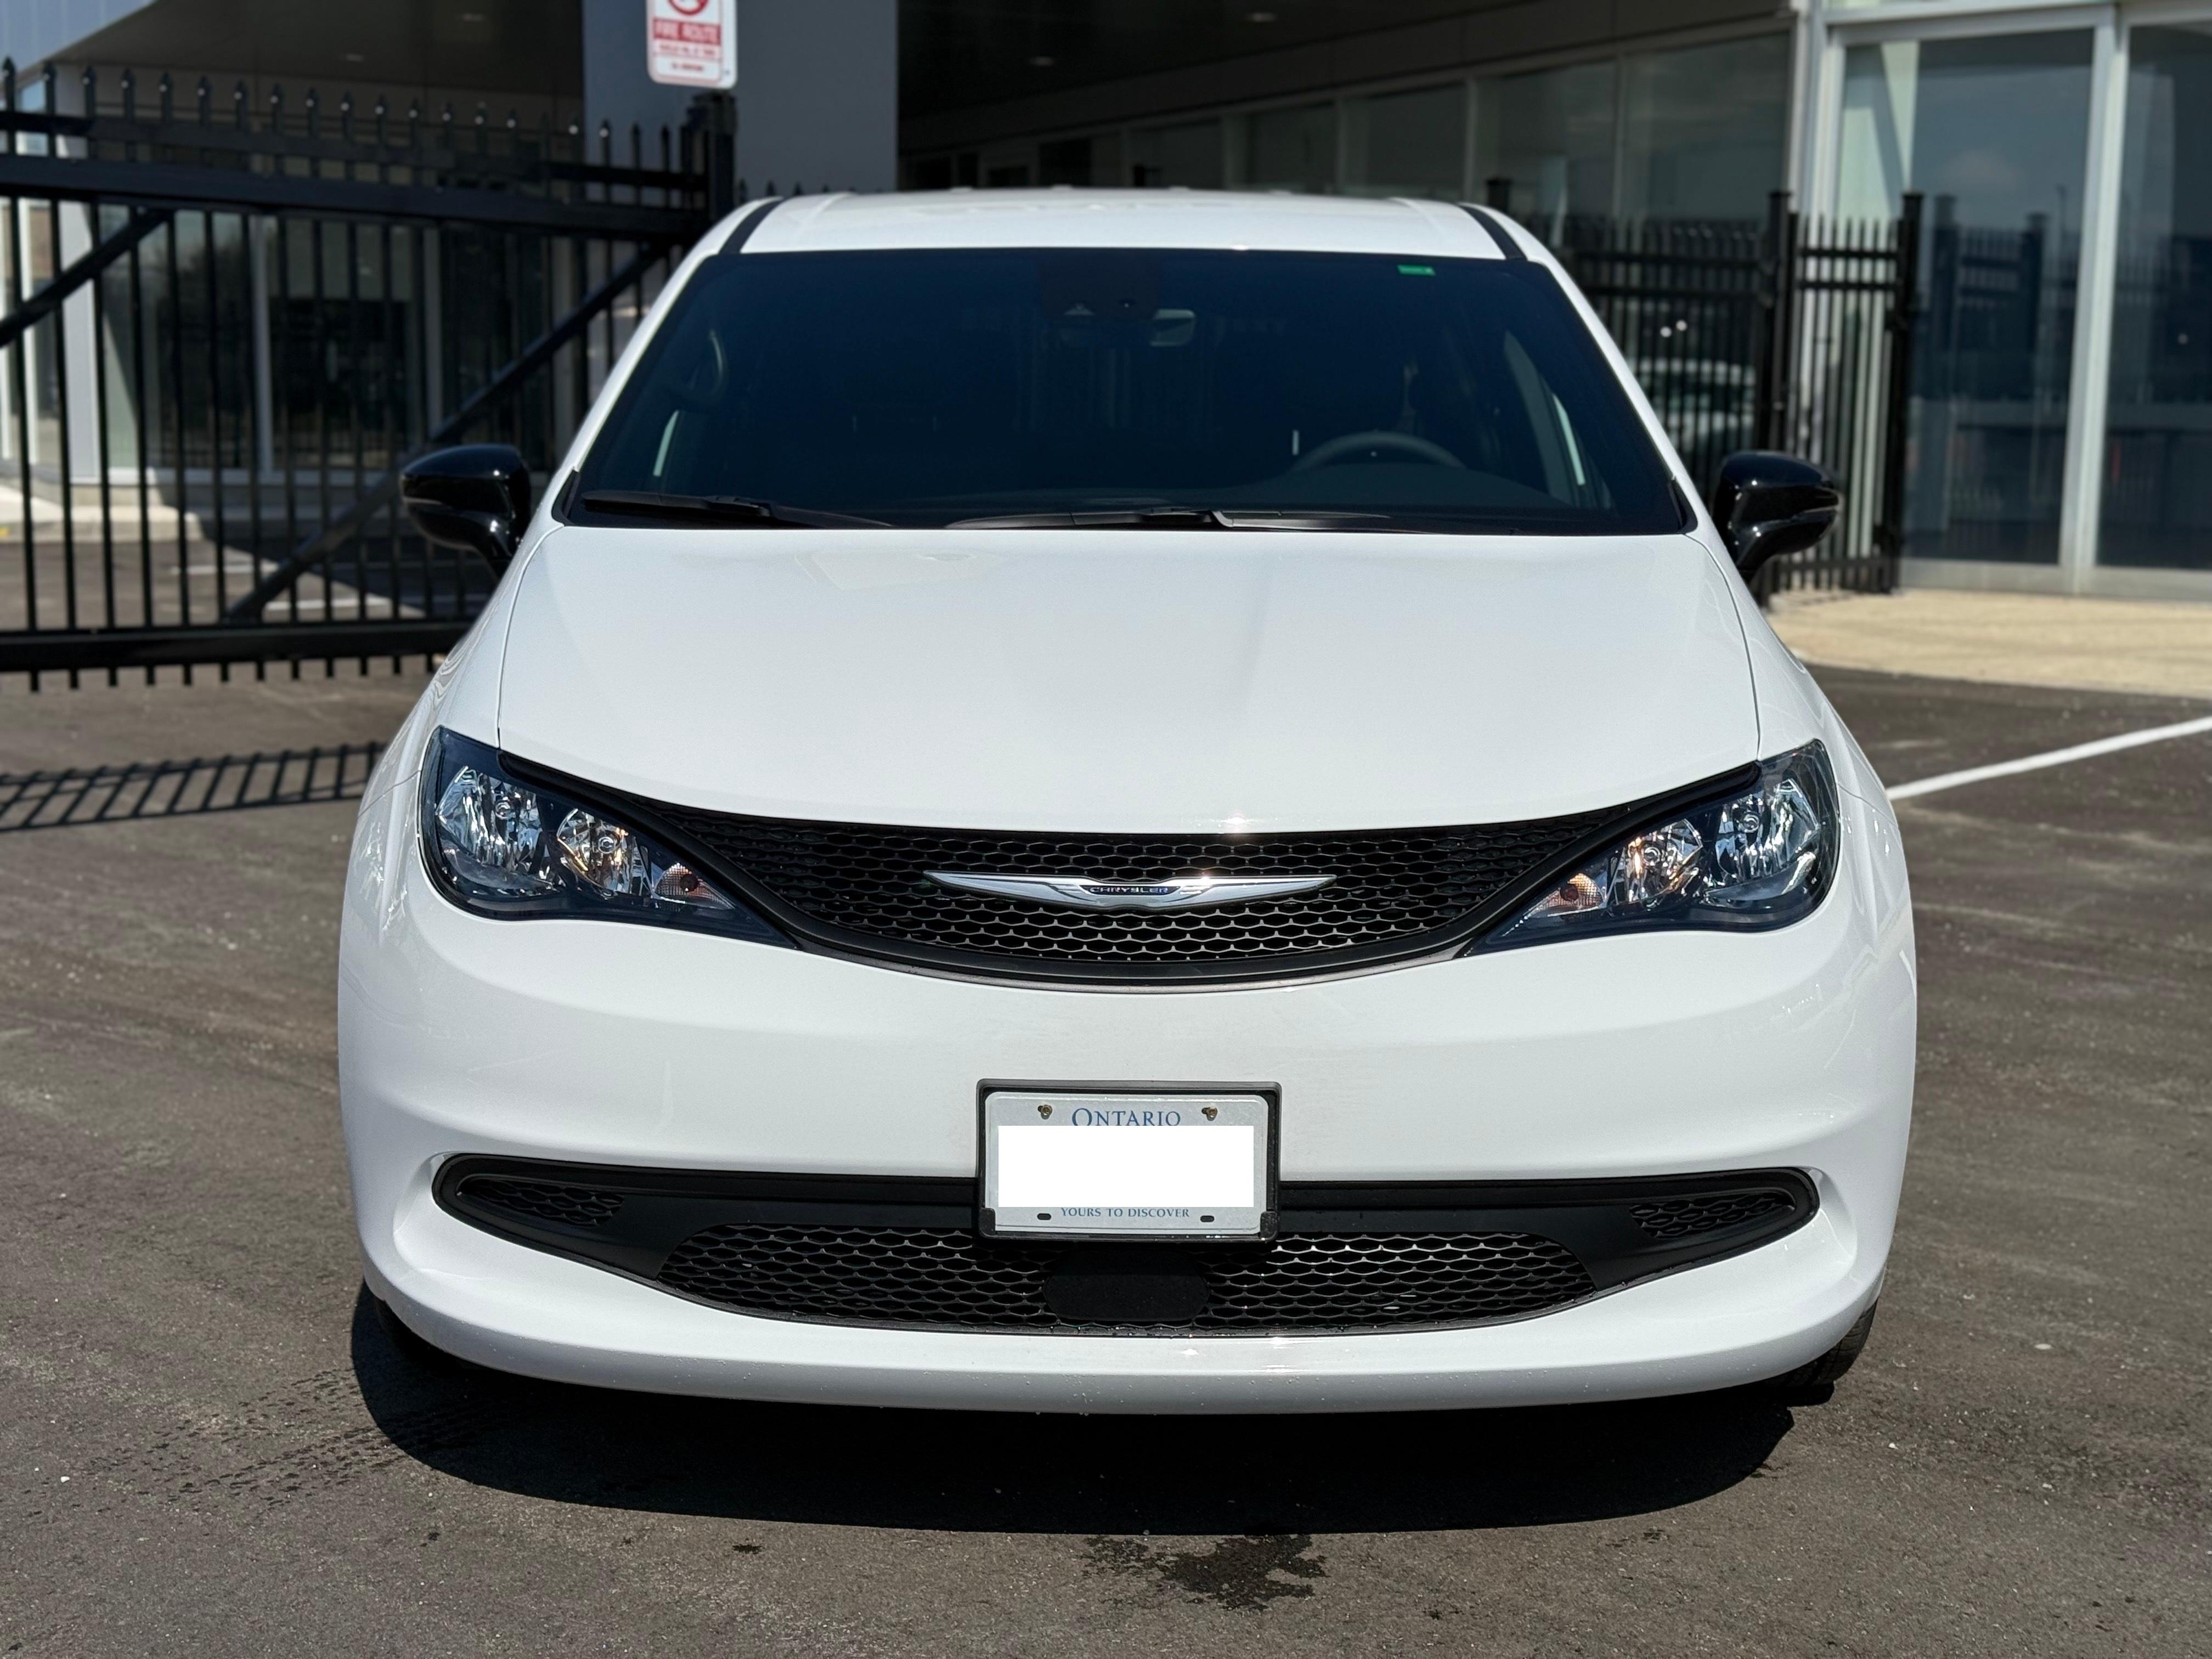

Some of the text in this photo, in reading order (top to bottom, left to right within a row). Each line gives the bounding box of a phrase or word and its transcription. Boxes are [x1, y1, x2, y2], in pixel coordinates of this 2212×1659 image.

[1072, 1108, 1181, 1126] ONTARIO
[1060, 1207, 1189, 1217] YOURS TO DISCOVER
